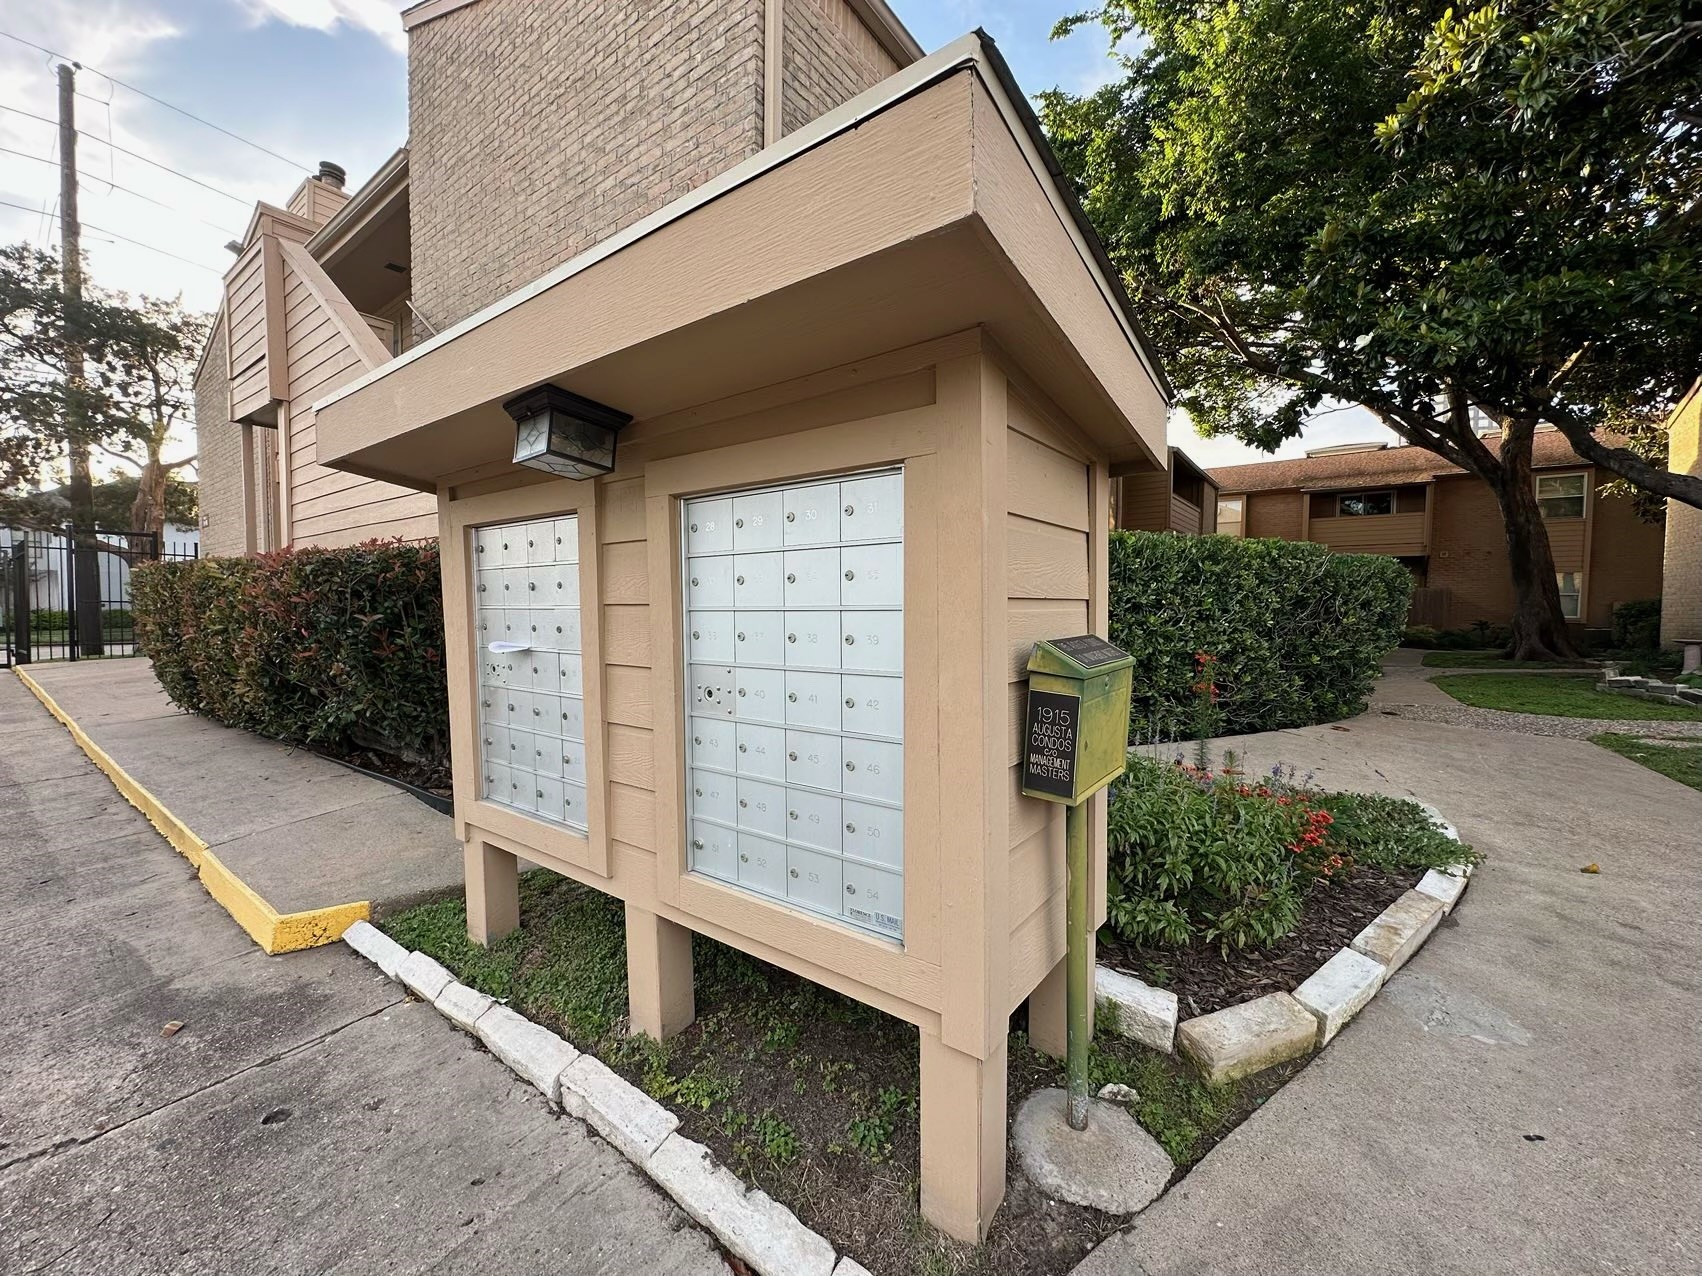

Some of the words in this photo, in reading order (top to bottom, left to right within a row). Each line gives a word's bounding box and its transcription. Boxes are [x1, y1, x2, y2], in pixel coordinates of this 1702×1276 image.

[867, 503, 878, 513] 31
[805, 509, 817, 521] 30
[752, 515, 764, 527] 29
[705, 522, 716, 532] 28
[808, 633, 818, 644] 38
[866, 634, 879, 645] 39
[754, 690, 766, 700] 40
[808, 695, 818, 704] 41
[866, 699, 880, 711] 42
[1037, 706, 1070, 726] 1915
[1032, 722, 1073, 740] AUGUSTA
[709, 738, 719, 748] 43
[1031, 734, 1072, 752] CONDOS
[755, 746, 766, 755] 44
[807, 754, 819, 764] 45
[1029, 753, 1071, 770] MANAGEMENT
[866, 763, 880, 775] 46
[1029, 763, 1070, 782] MASTERS
[710, 791, 720, 800] 47
[756, 802, 767, 812] 48
[808, 813, 820, 824] 49
[866, 827, 880, 838] 50
[757, 858, 767, 868] 52
[808, 872, 819, 883] 53
[866, 889, 879, 900] 54
